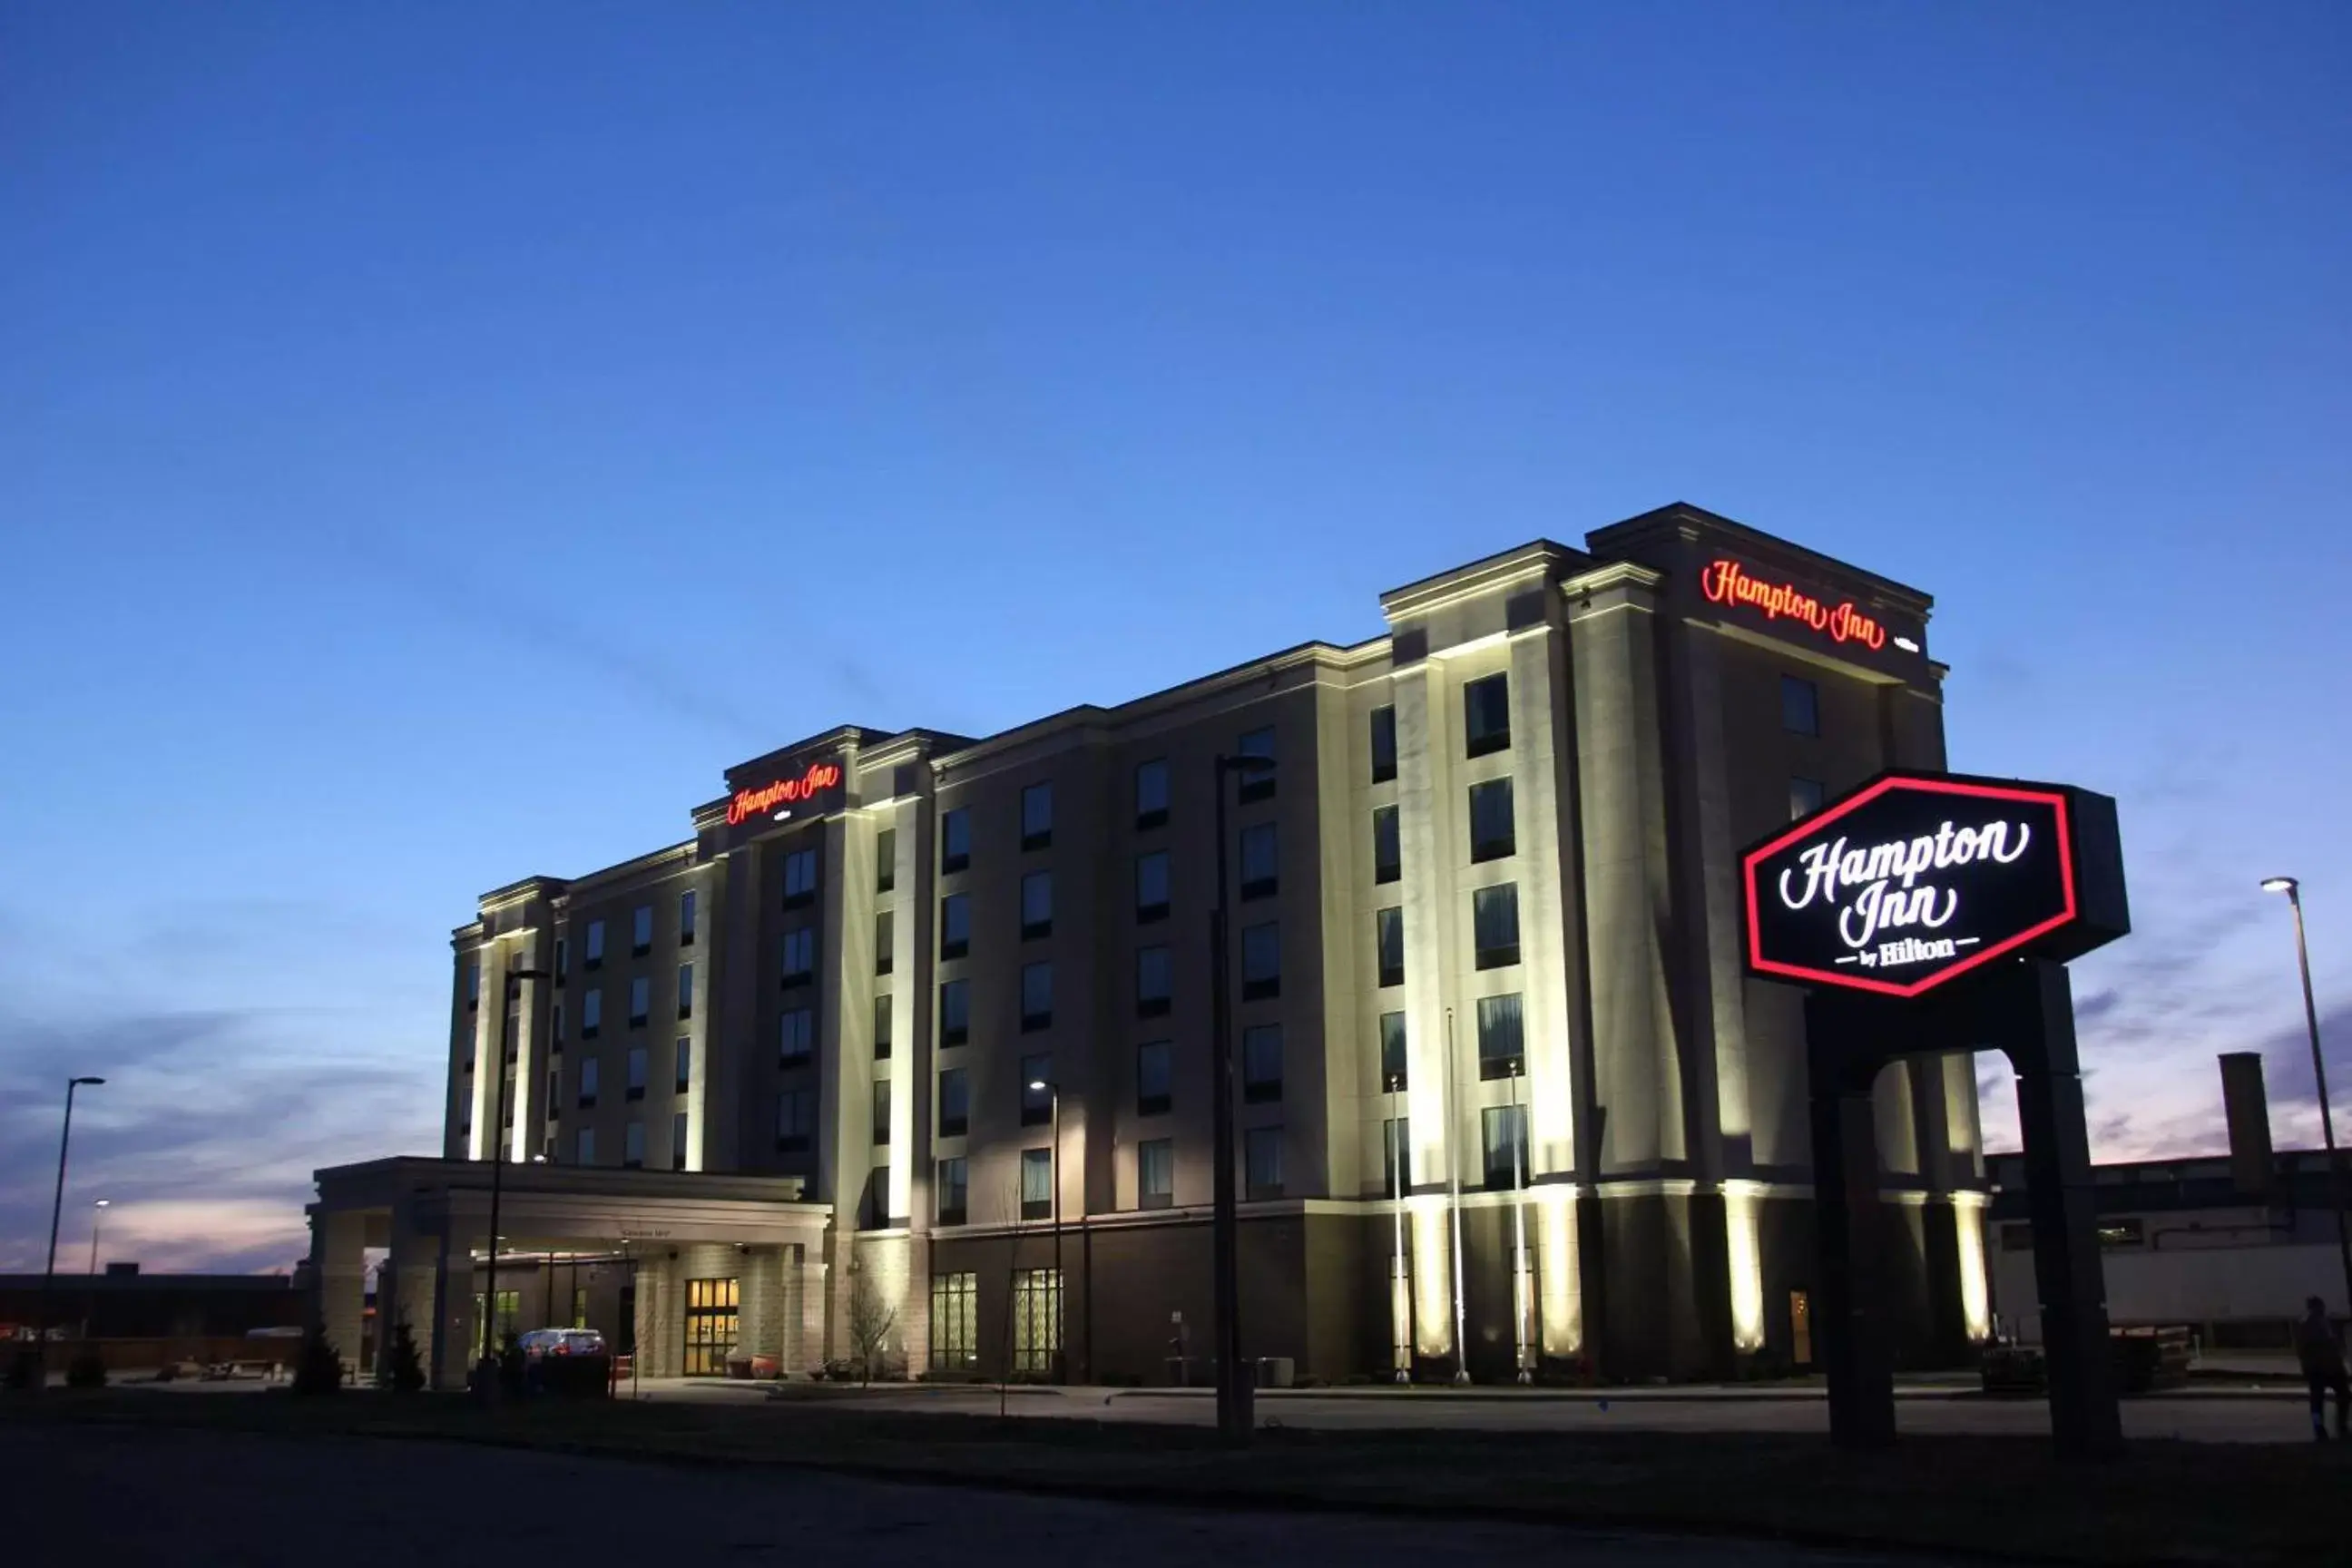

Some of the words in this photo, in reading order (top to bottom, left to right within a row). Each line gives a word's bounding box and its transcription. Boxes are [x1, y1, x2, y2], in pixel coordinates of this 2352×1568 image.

[1702, 560, 1828, 630] Hampton
[1829, 603, 1885, 650] Inn
[727, 780, 799, 825] Hampton
[801, 764, 839, 799] Inn
[1779, 820, 2030, 909] Hampton
[1839, 879, 1957, 948] Inn
[1859, 950, 1877, 967] by
[1878, 937, 1955, 966] Hilton
